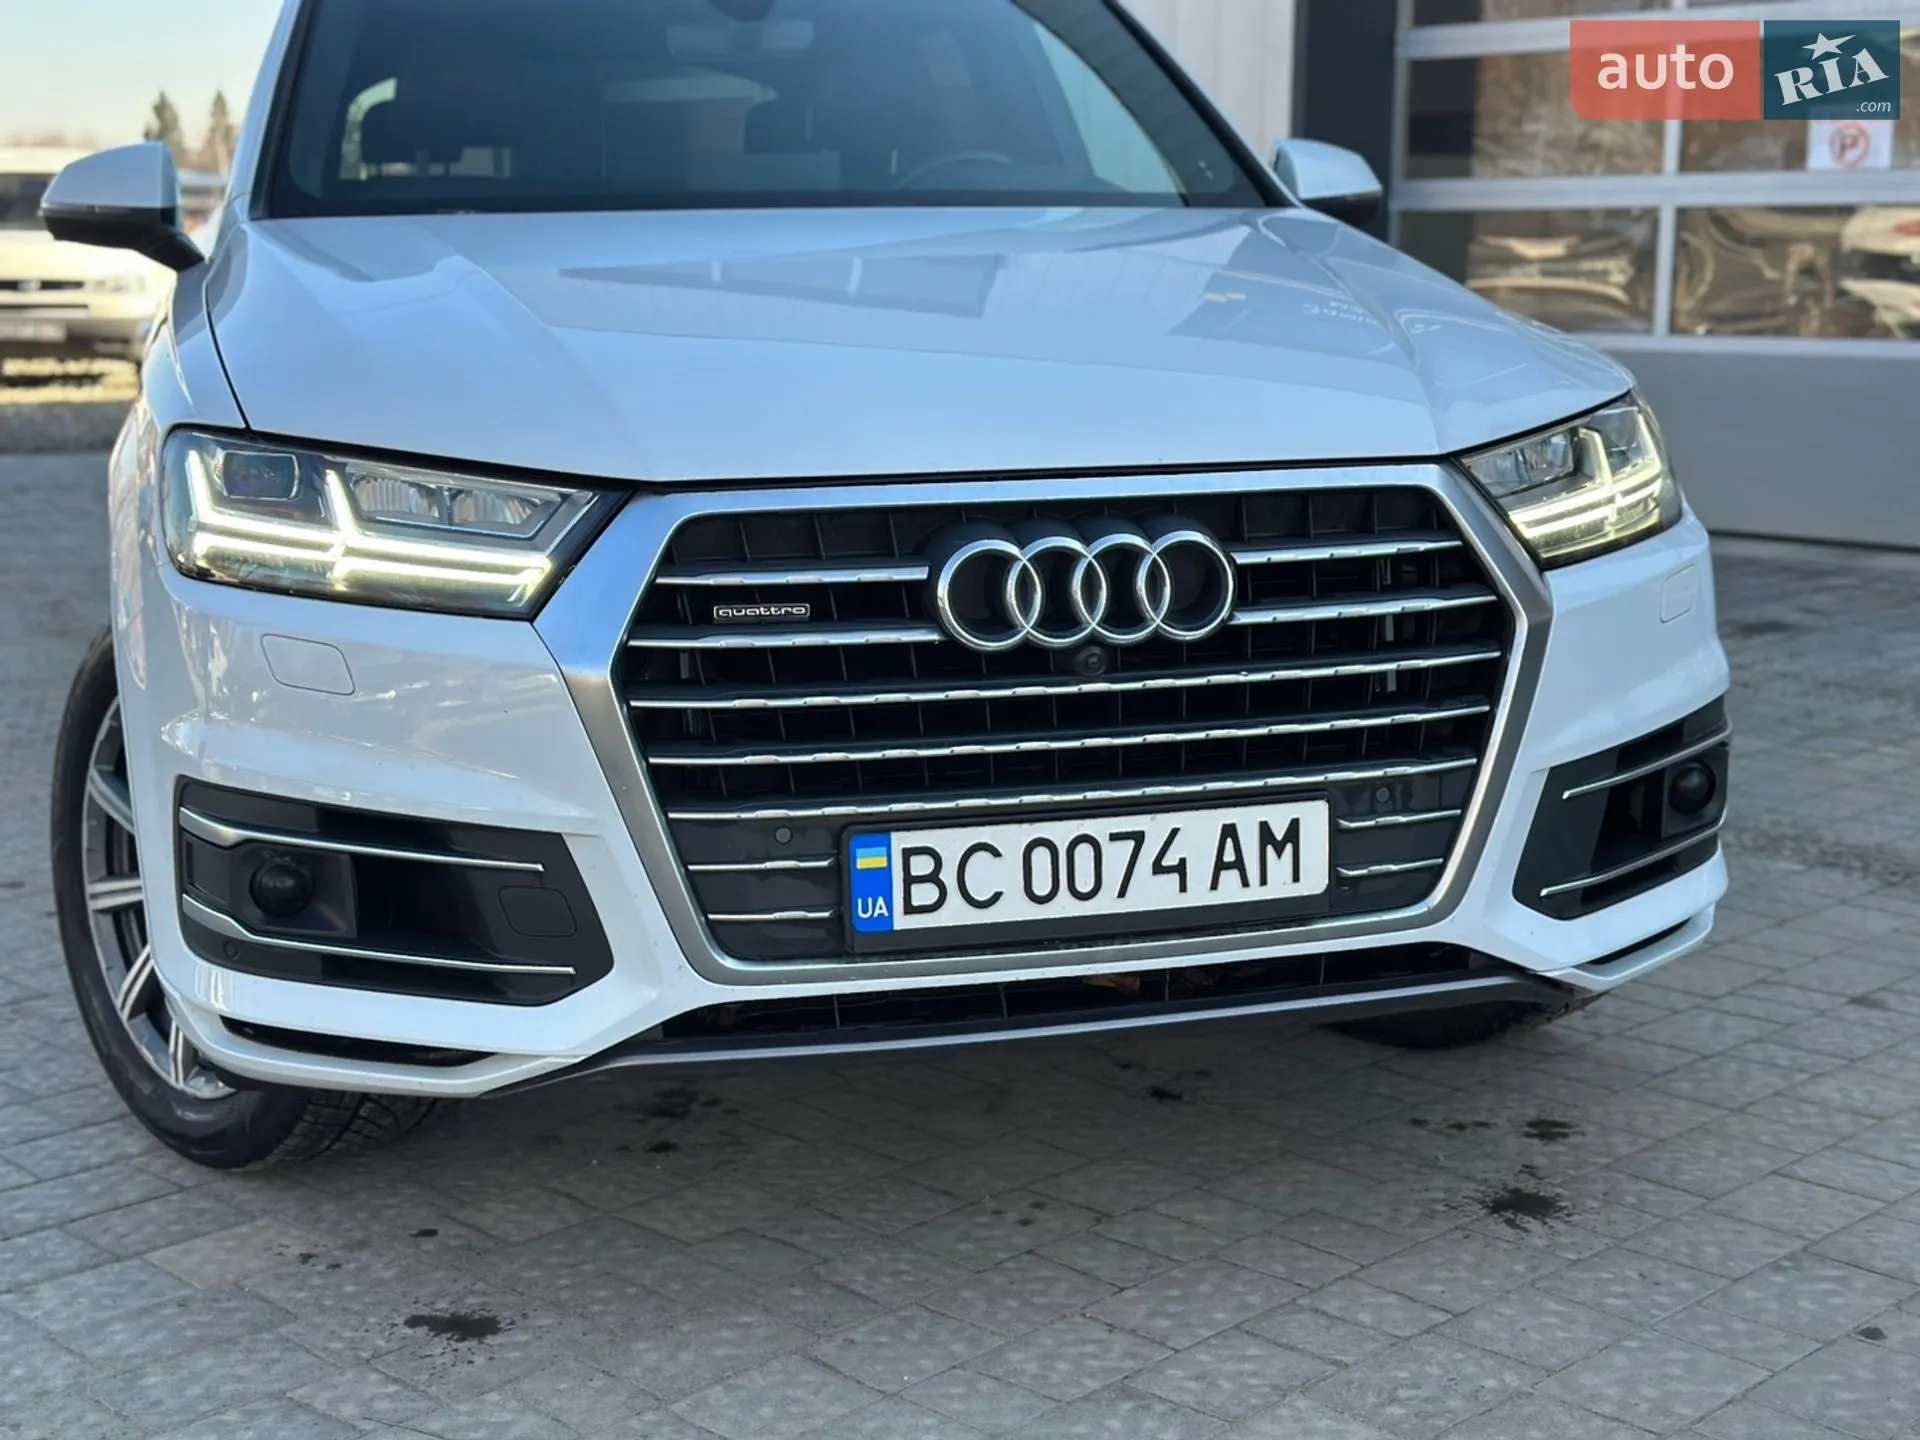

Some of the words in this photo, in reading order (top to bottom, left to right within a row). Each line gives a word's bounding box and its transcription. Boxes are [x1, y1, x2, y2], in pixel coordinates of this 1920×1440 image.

[718, 606, 806, 617] quattro
[902, 841, 1004, 916] BC
[1022, 827, 1188, 906] 0074
[1209, 817, 1301, 892] AM
[857, 896, 889, 919] UA
